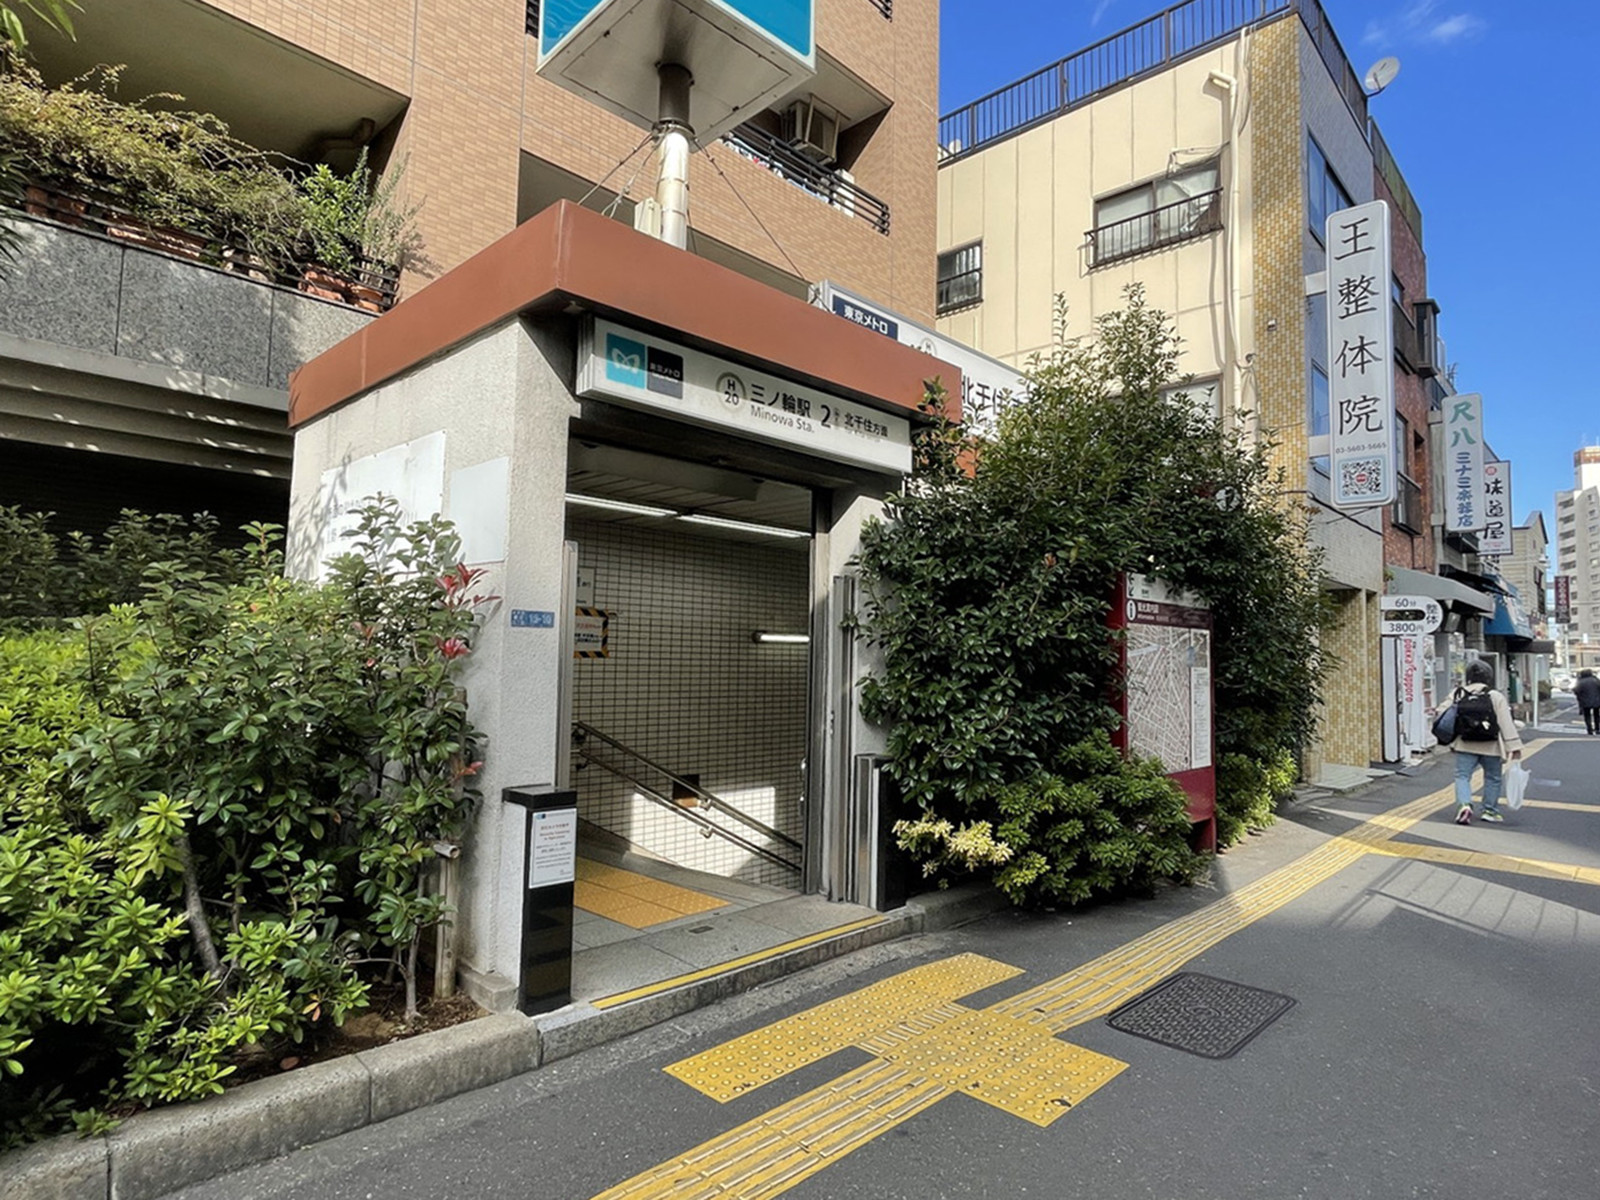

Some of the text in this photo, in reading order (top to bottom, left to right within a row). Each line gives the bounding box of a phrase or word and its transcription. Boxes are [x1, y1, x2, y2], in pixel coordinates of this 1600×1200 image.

[843, 303, 888, 335] 東京メトロ
[1334, 217, 1384, 436] 王整体院
[723, 391, 740, 406] 20
[727, 379, 736, 392] H
[750, 383, 811, 419] 三ノ輪駅
[820, 404, 831, 429] 2
[750, 404, 816, 434] Minowa Sta.
[1450, 401, 1477, 447] 尺八
